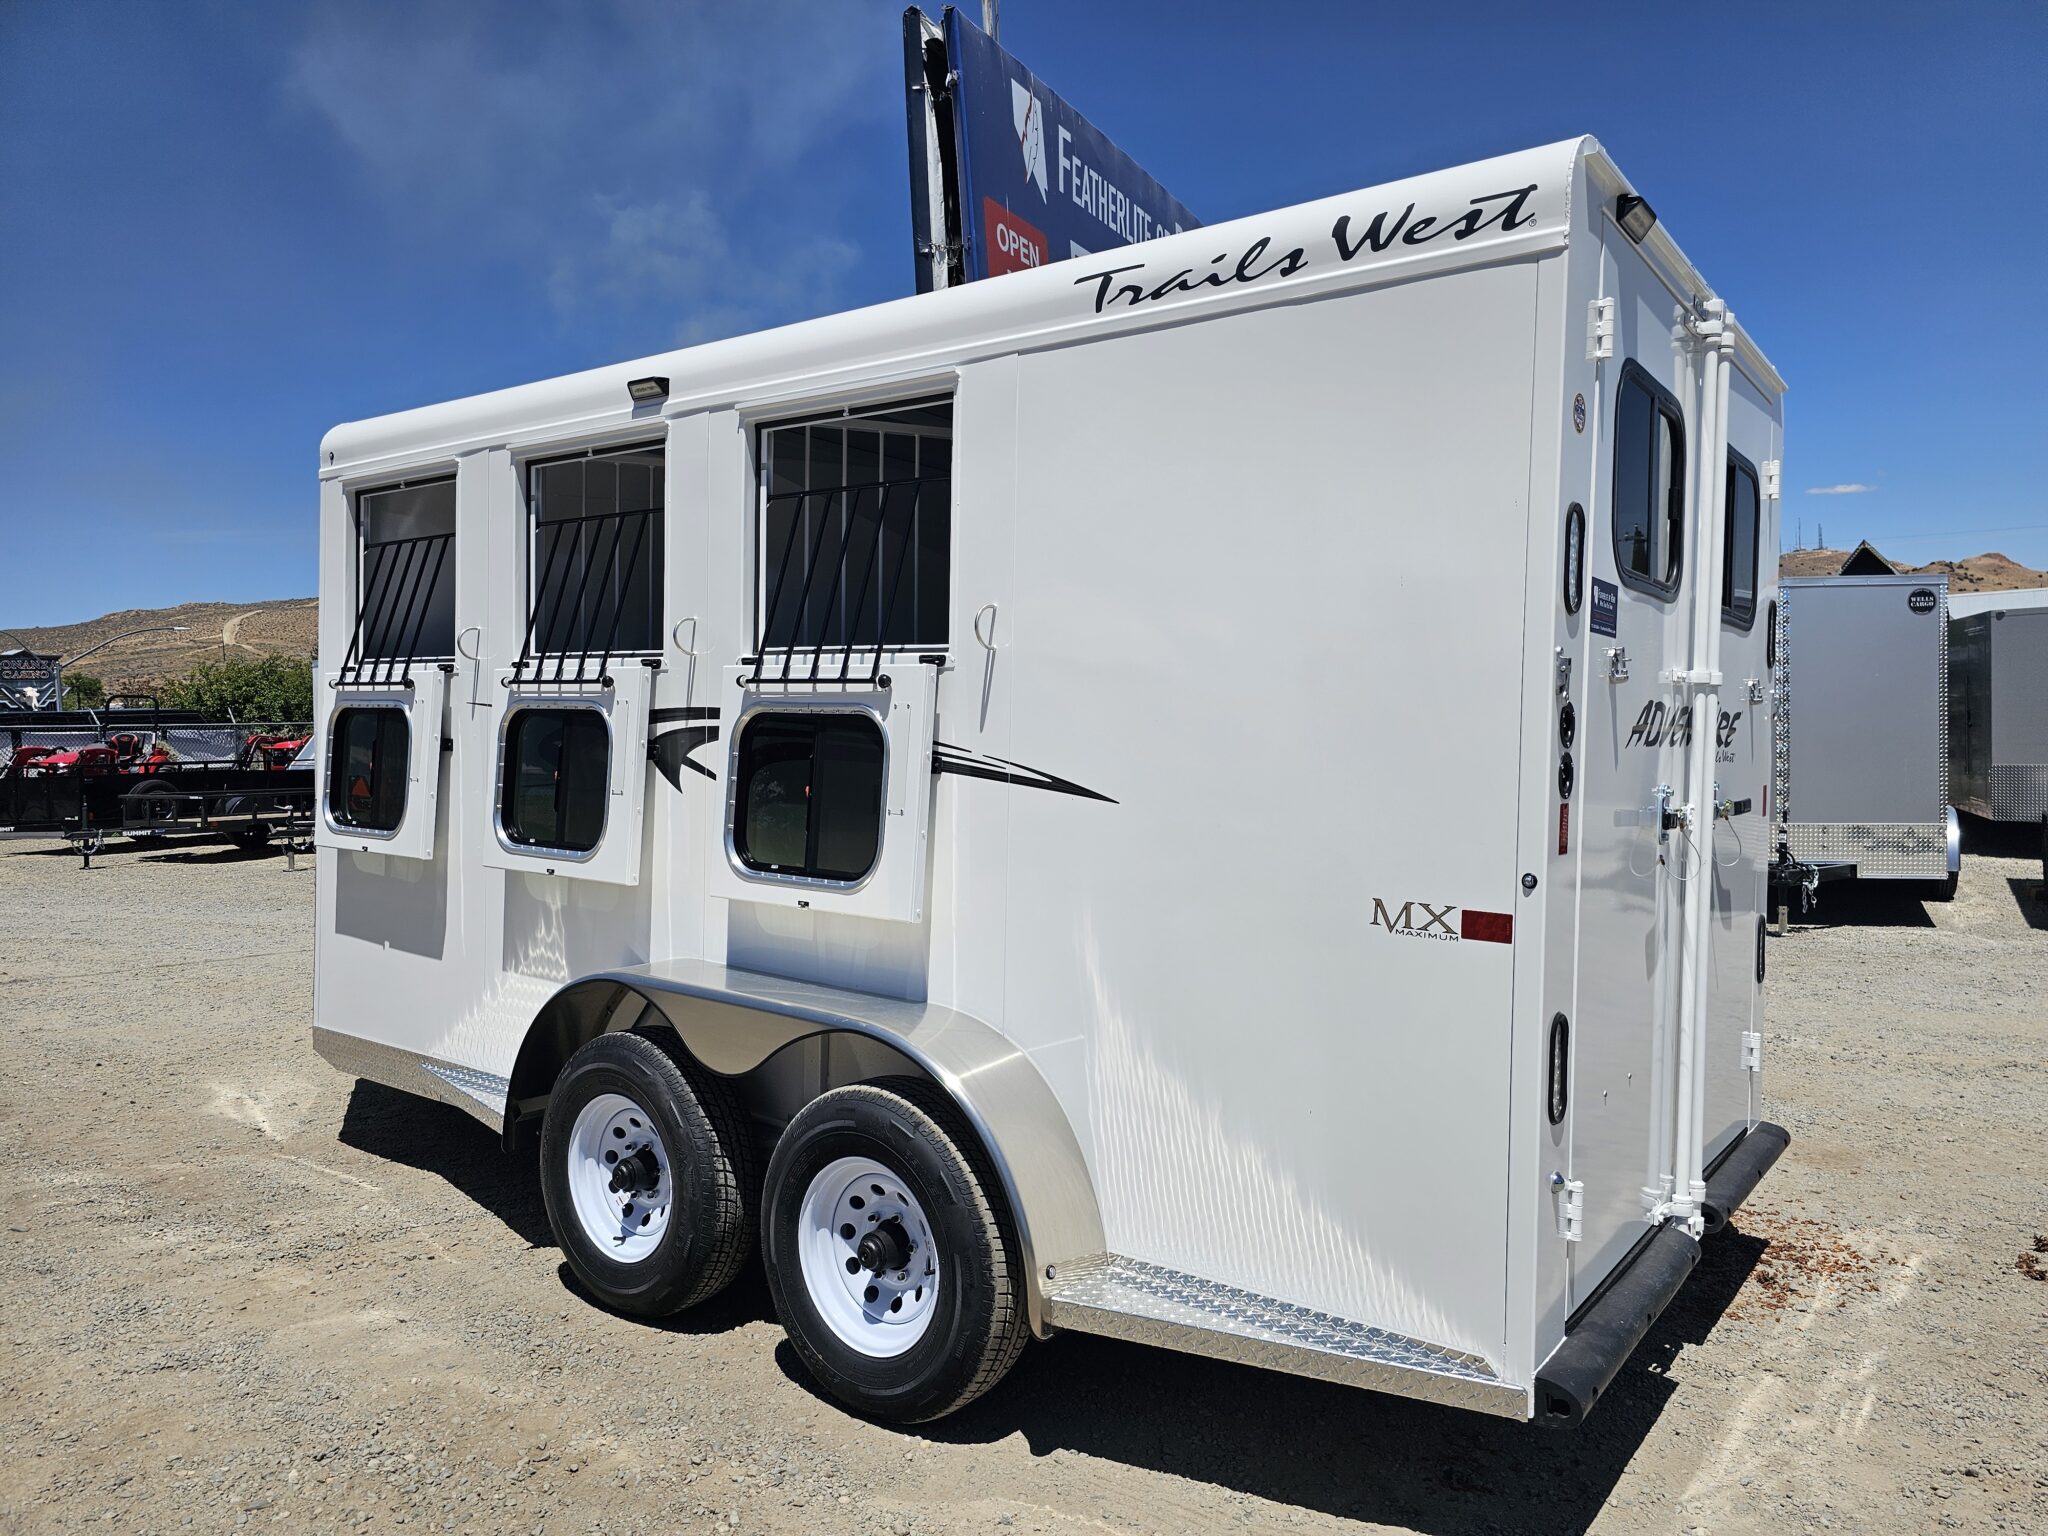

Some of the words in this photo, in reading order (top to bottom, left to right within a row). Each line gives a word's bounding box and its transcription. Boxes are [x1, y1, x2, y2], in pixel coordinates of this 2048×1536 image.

[1058, 124, 1152, 245] FEATHERLITE
[996, 223, 1040, 268] OPEN
[1074, 236, 1308, 313] Trails
[1331, 184, 1538, 262] West
[0, 659, 58, 670] ONANZA
[1, 670, 50, 679] CASINO
[1625, 700, 1742, 749] ADVENRE
[122, 829, 152, 837] SUMMIT
[1369, 897, 1459, 934] MX
[1395, 928, 1459, 942] MAXIMUM
